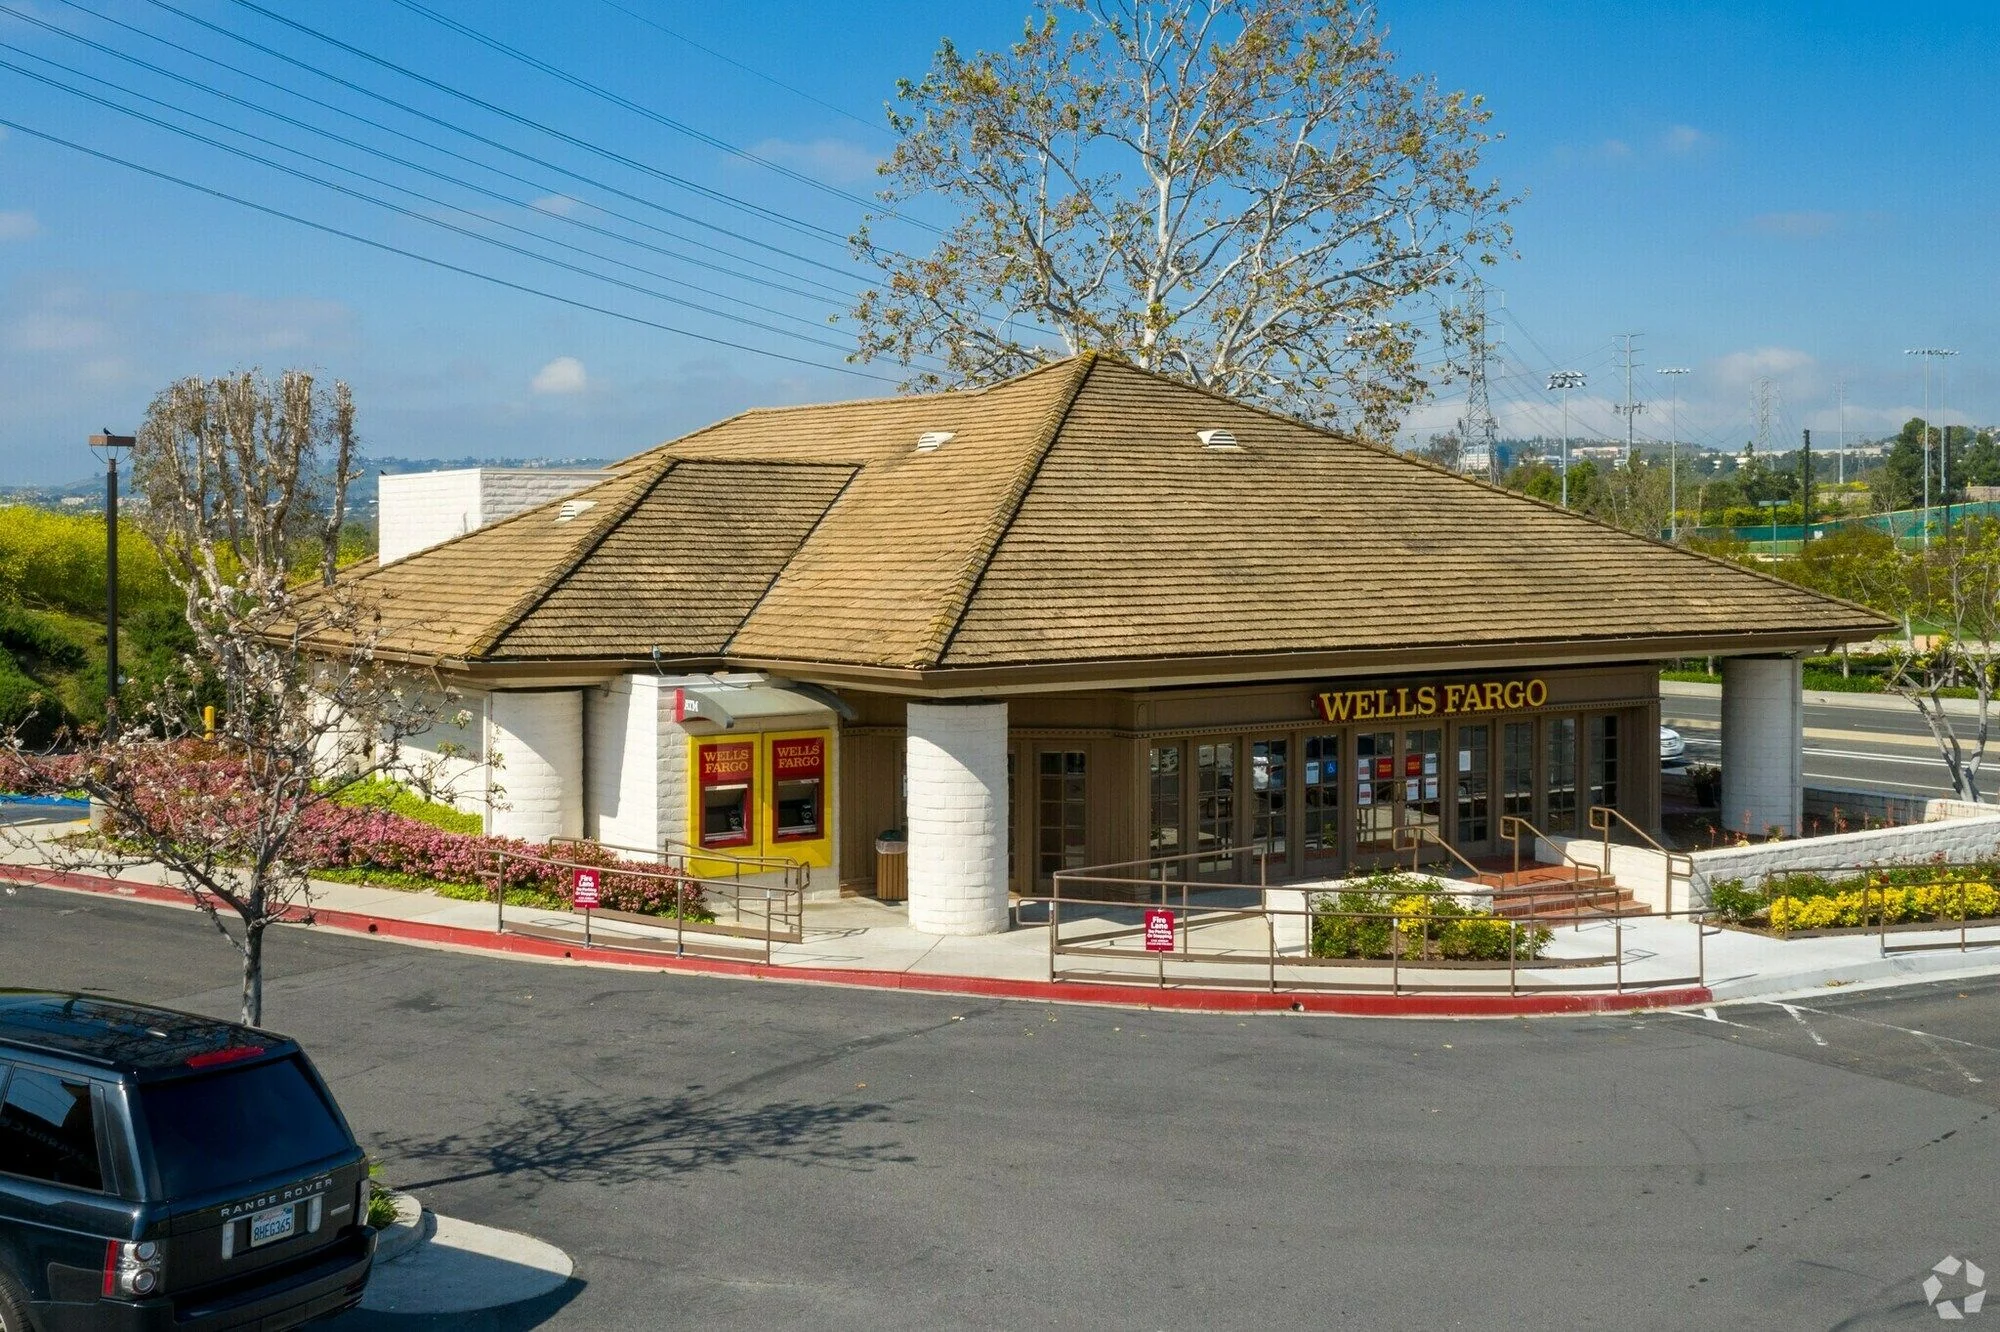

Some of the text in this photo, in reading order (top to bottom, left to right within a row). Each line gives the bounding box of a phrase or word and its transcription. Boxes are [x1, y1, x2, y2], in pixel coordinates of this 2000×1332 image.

[684, 699, 699, 712] ATM
[1319, 679, 1548, 722] WELLS FARGO
[703, 749, 749, 762] WELLS
[777, 745, 820, 757] WELLS
[705, 761, 749, 774] FARGO
[778, 756, 820, 769] FARGO
[1150, 922, 1169, 930] Lane
[1152, 916, 1167, 924] Fire
[221, 1195, 277, 1217] RANGE
[284, 1178, 333, 1199] ROVER
[253, 1217, 291, 1241] 8HEG365
